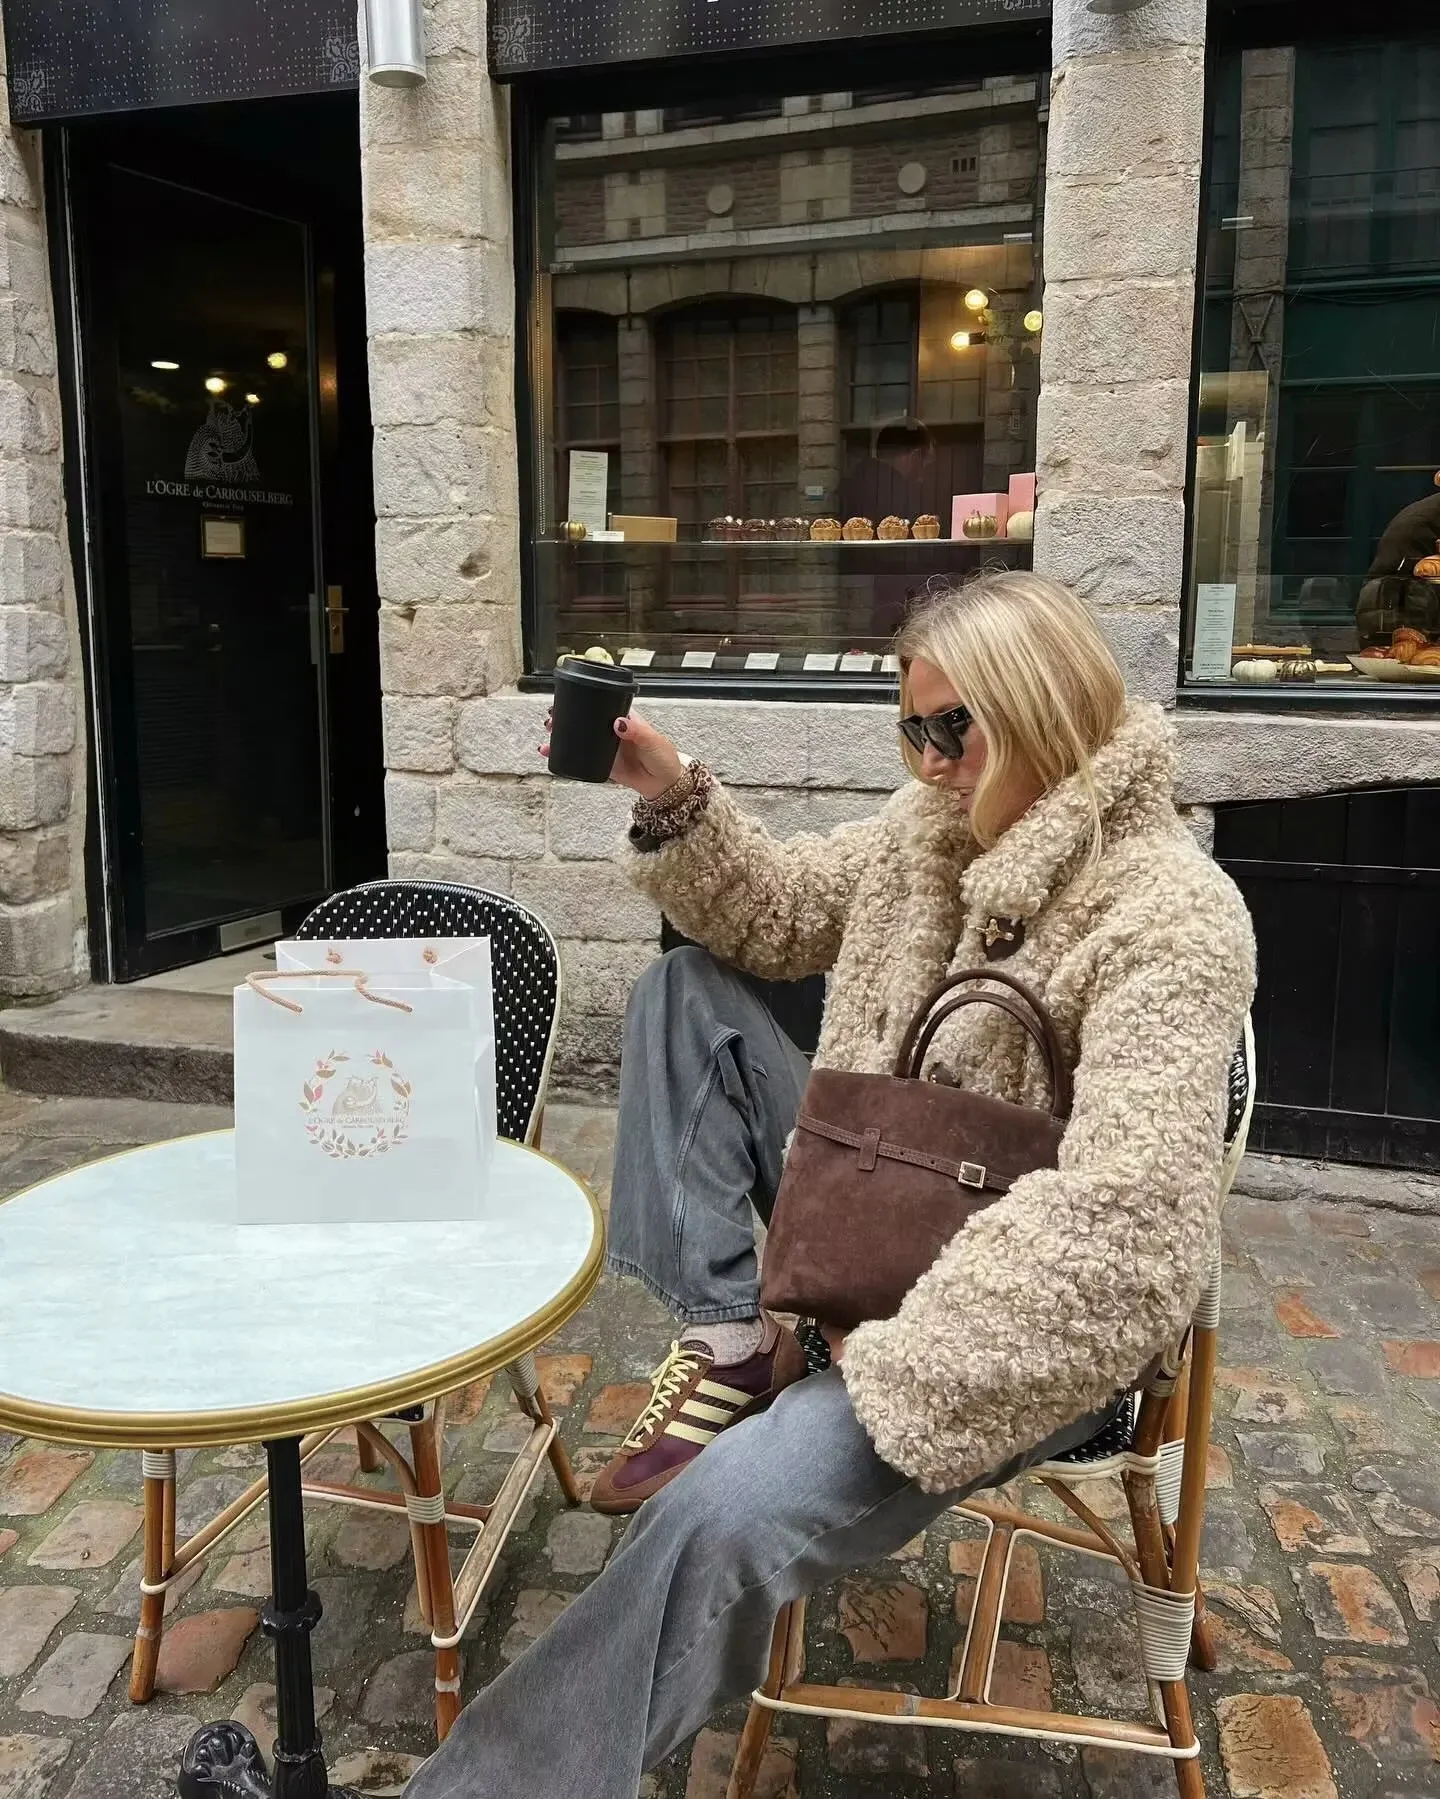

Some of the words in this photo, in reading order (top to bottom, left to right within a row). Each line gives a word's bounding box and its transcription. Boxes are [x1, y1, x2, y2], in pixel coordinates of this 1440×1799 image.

[146, 480, 191, 496] L'OGRE
[193, 485, 203, 498] de
[206, 485, 293, 505] CARROUSELBERG
